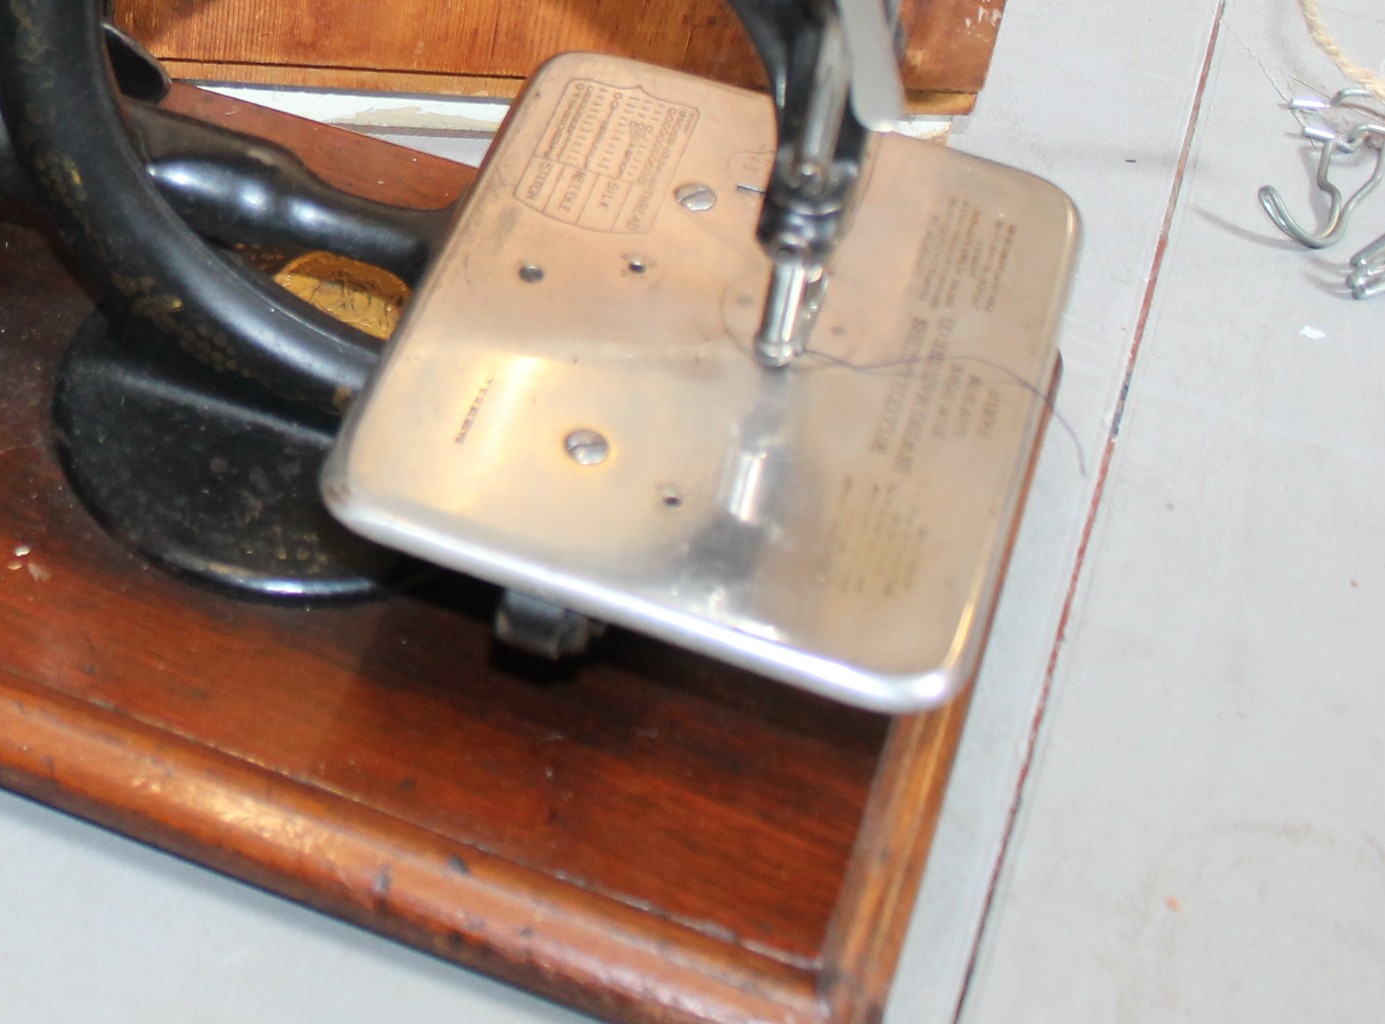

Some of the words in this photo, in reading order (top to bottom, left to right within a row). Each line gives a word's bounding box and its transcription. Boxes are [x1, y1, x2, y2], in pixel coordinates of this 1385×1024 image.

[557, 169, 587, 213] NEEDLE
[597, 180, 620, 211] SILK
[625, 188, 653, 231] THREAD
